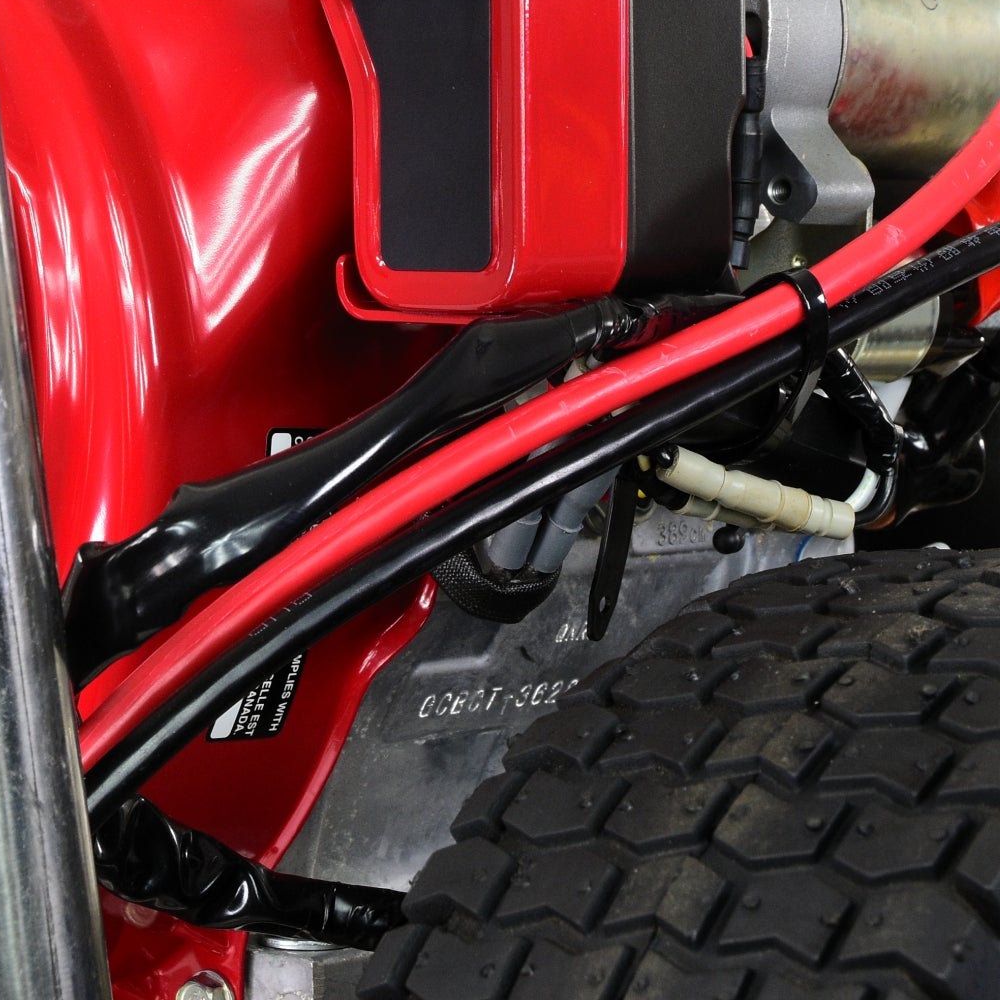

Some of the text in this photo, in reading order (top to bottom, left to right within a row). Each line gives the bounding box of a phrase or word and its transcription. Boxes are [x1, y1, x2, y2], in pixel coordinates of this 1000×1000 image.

[233, 684, 260, 735] ANADA.
[244, 674, 275, 737] ELLE EST
[269, 701, 286, 732] WITH
